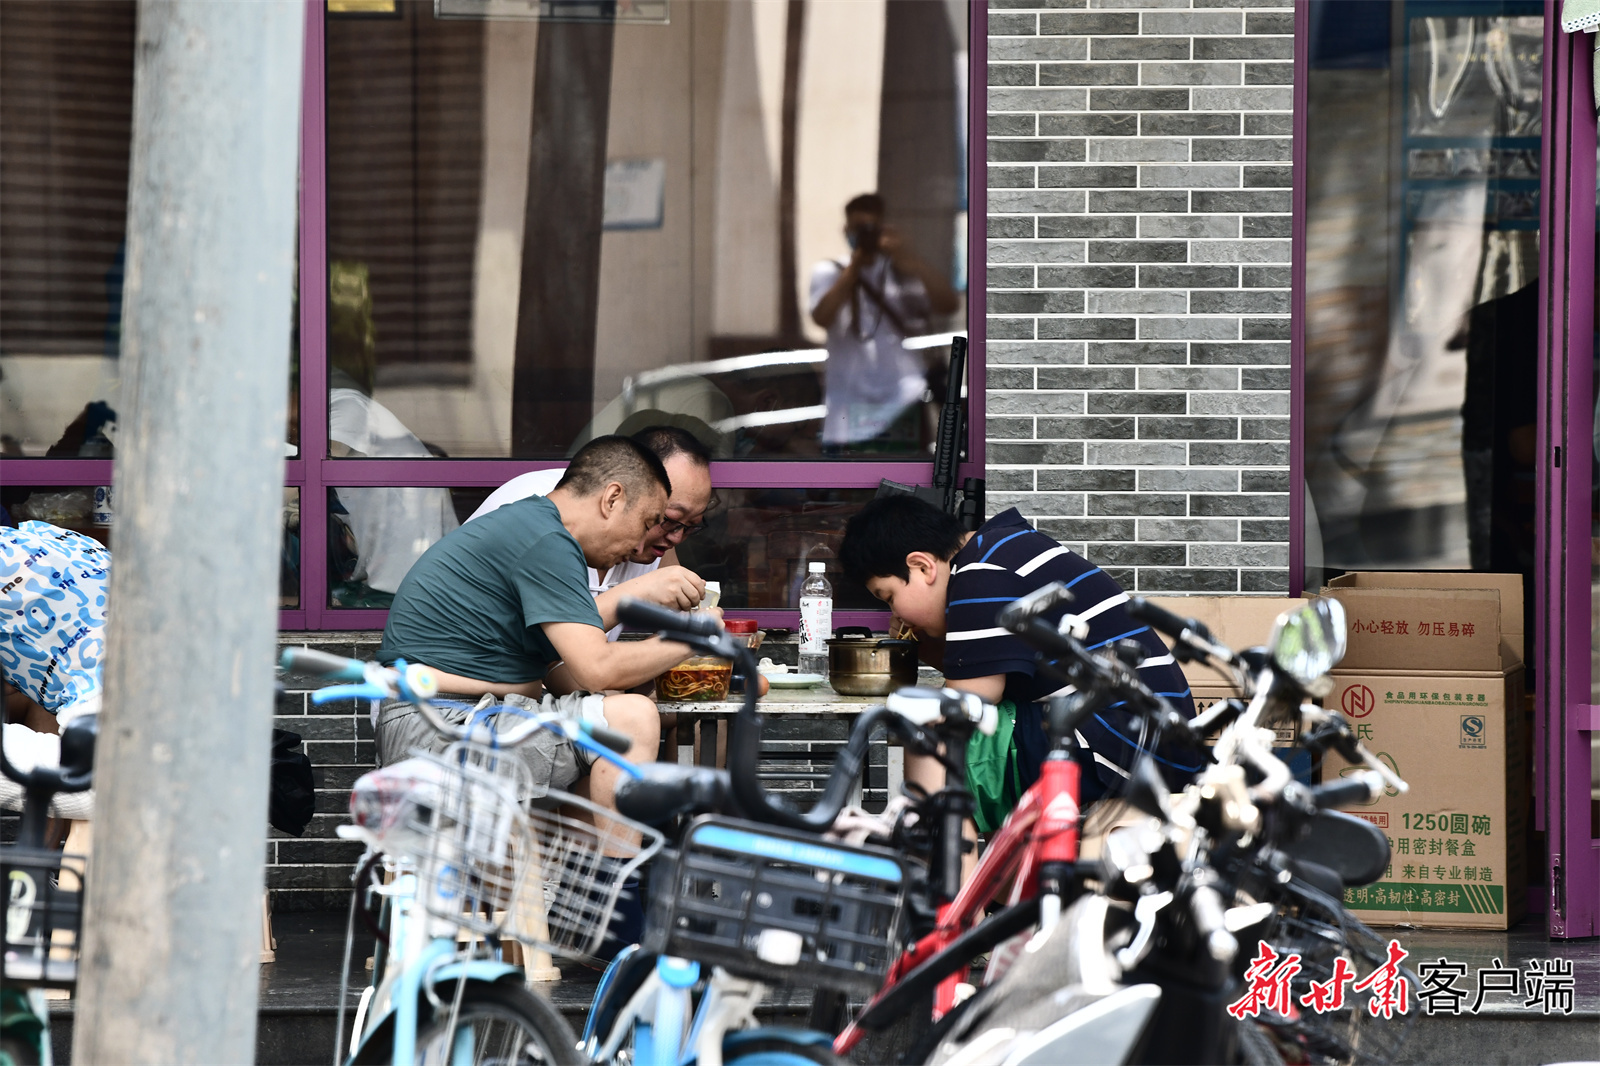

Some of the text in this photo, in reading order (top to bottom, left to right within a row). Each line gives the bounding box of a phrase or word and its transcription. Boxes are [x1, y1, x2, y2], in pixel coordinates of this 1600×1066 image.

[1352, 619, 1475, 637] 小心轻放 勿压易碎
[58, 627, 91, 655] back
[1385, 691, 1486, 702] 食品用环保包装容器
[1402, 812, 1491, 836] 1250圆碗
[1402, 863, 1493, 882] 来自专业制造
